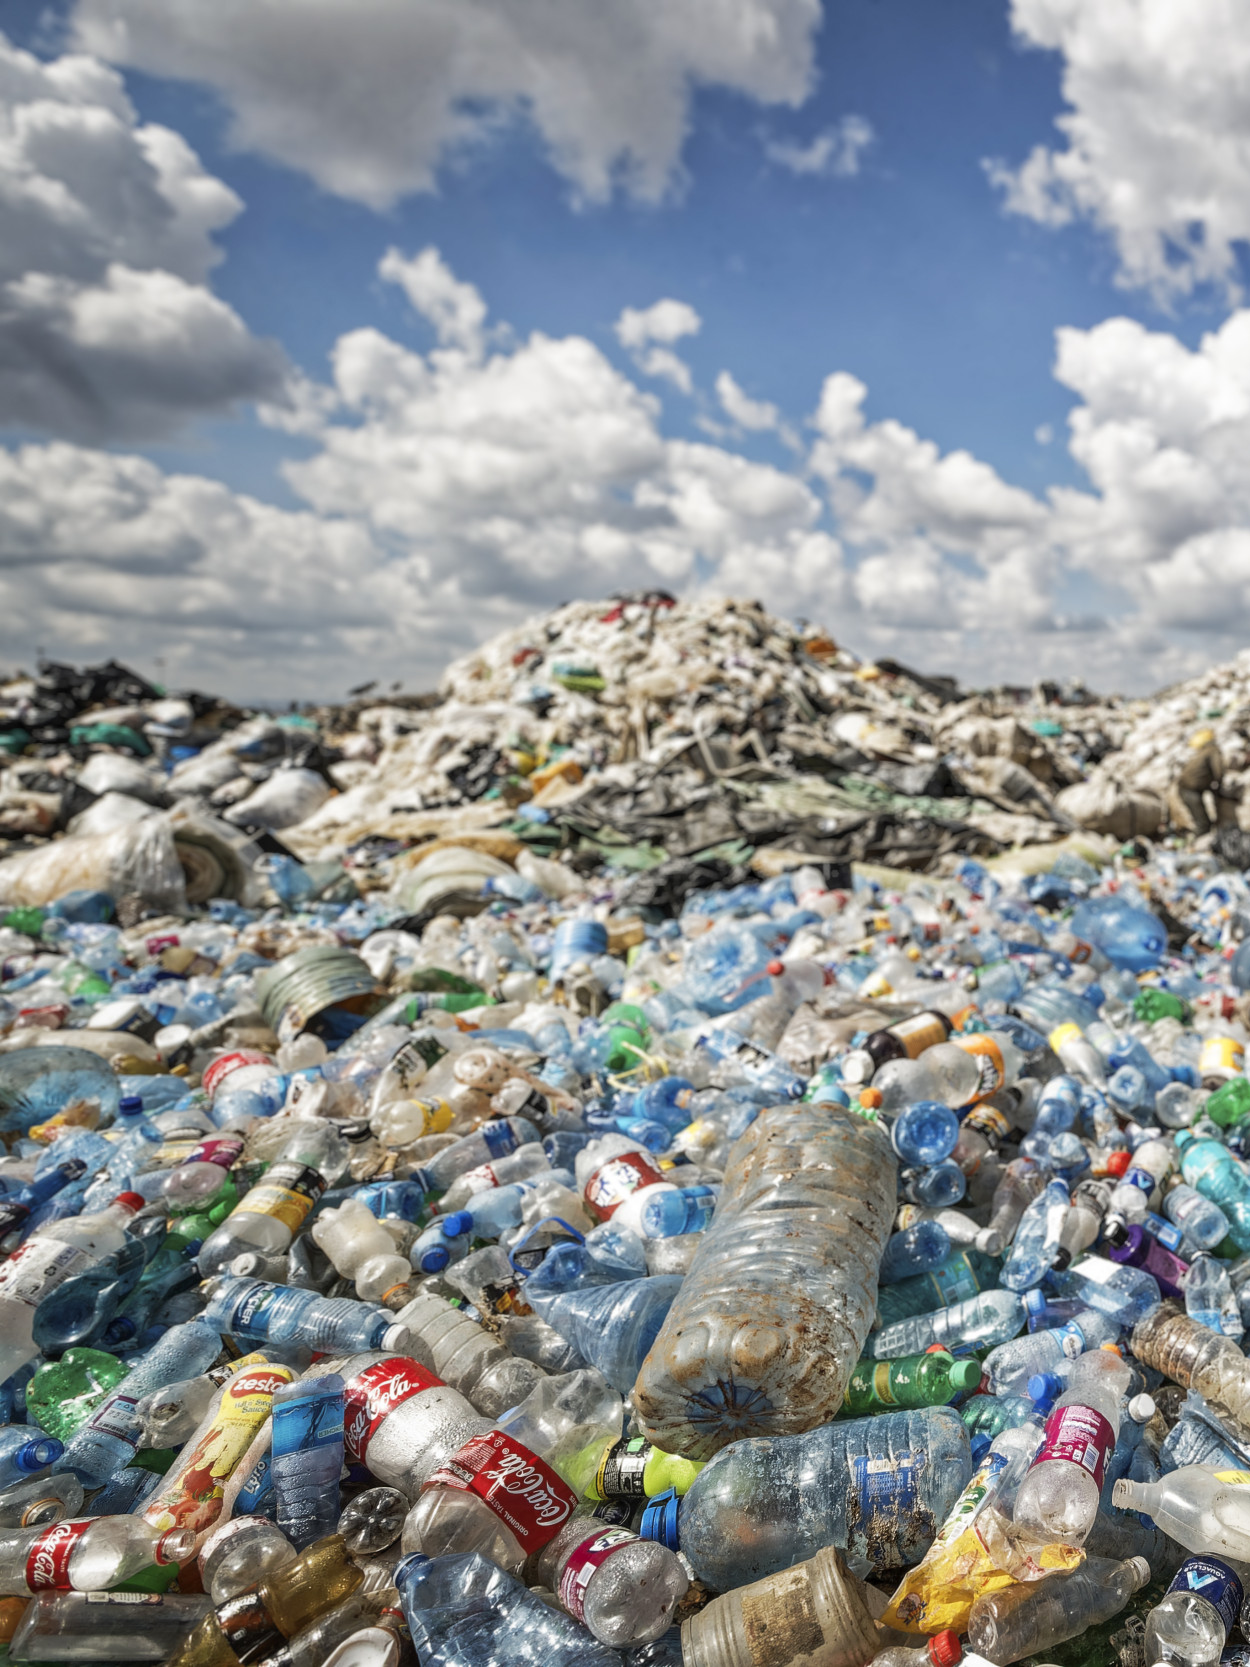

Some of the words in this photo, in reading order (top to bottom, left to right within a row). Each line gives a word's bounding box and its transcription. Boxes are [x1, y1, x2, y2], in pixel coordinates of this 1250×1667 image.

[482, 1451, 571, 1528] Coca-Cola
[485, 1495, 503, 1513] TASTE
[501, 1511, 529, 1536] ORIGINAL
[33, 1524, 71, 1585] Coca-Cola
[1184, 1563, 1226, 1581] AQUACLEAR
